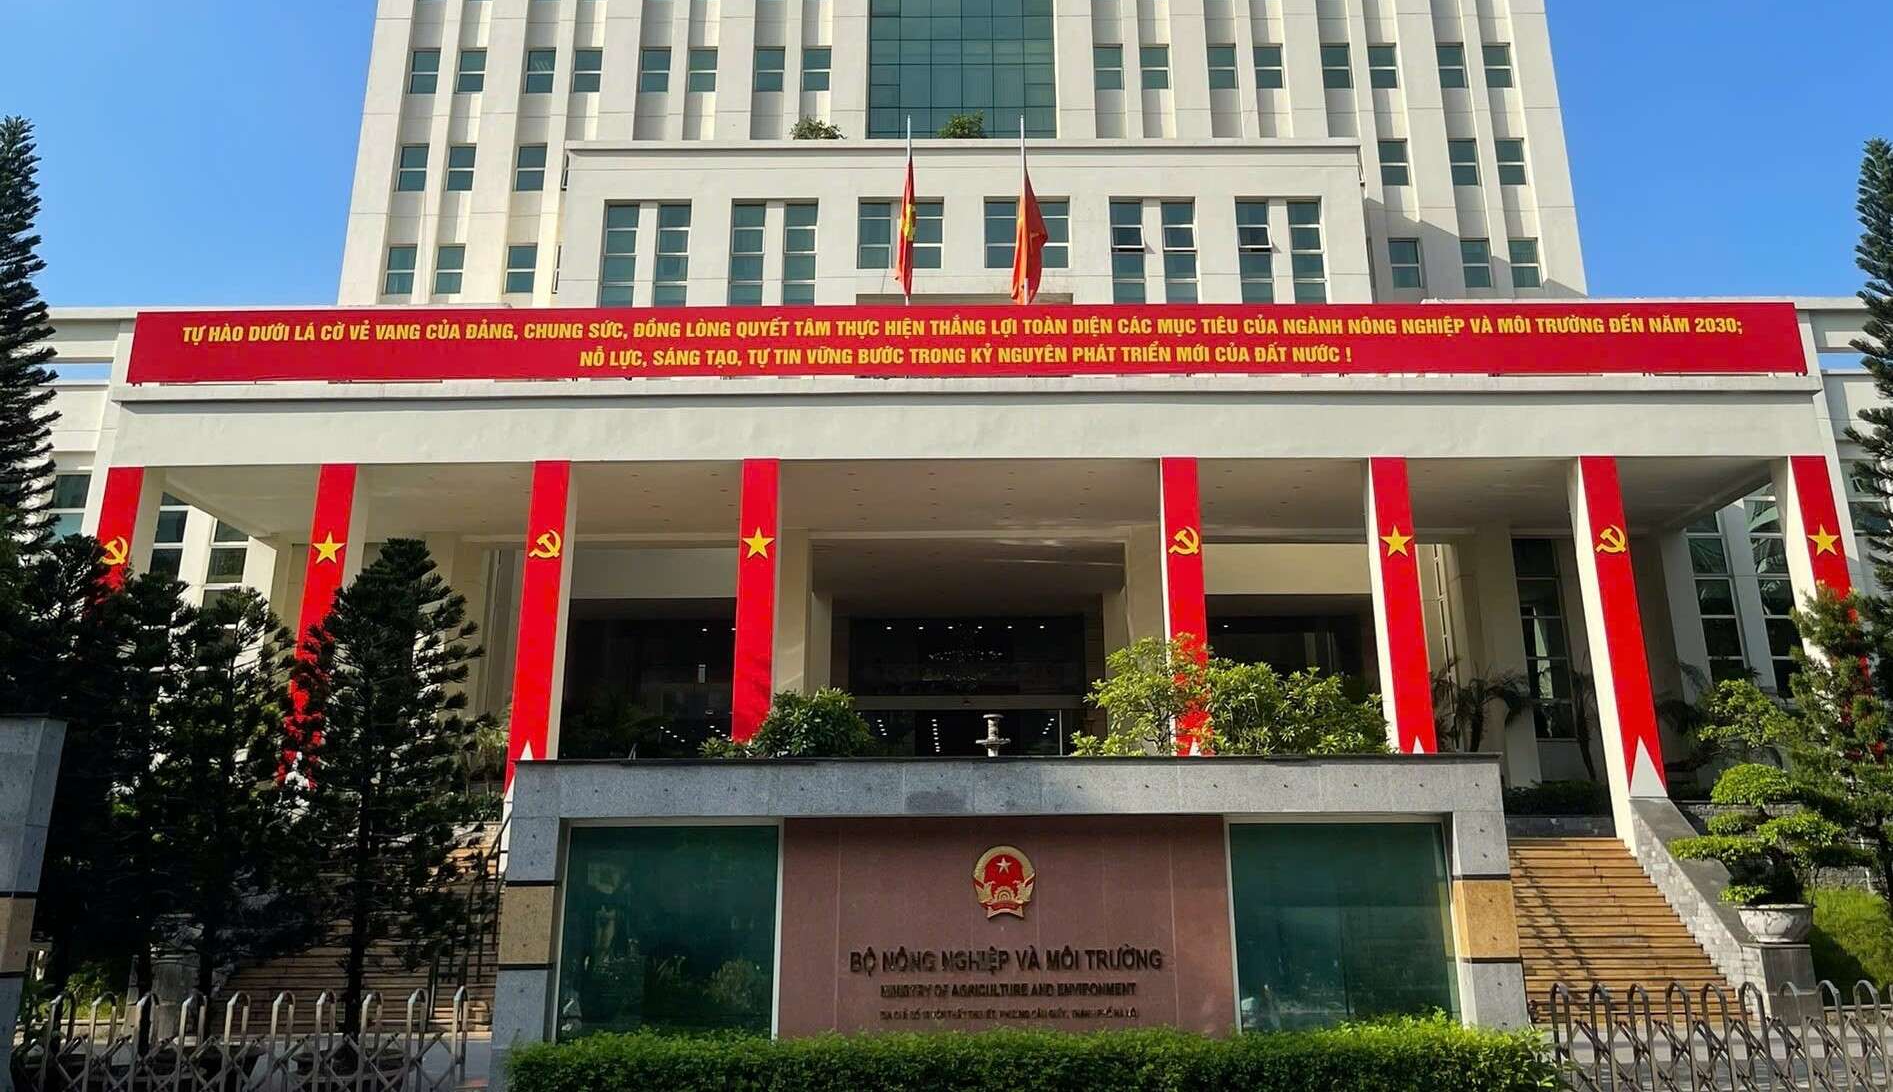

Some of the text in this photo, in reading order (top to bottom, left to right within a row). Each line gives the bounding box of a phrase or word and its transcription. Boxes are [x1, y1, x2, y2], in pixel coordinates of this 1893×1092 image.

[182, 312, 1743, 346] TỰ HÀO DƯỚI LÁ CỜ VẺ VANG CỦA ĐẢNG, CHUNG SỨC, ĐỒNG LÒNG QUYẾT TÂM THỰC HIỆN THẮNG LỢI TOÀN DIỆN CÁC MỤC TIÊU CỦA NGÀNH NÔNG NGHIỆP VÀ MÔI TRƯỜNG ĐẾN NĂM 2030;
[579, 345, 605, 367] NỖ
[609, 348, 648, 370] LỰC,
[652, 346, 701, 366] SÁNG
[704, 349, 743, 369] TẠO,
[746, 347, 772, 369] TỰ
[773, 348, 802, 365] TIN
[806, 345, 853, 365] VỮNG
[857, 345, 905, 365] BƯỚC
[908, 347, 966, 364] TRONG
[970, 342, 994, 364] KỶ
[997, 343, 1068, 364] NGUYÊN
[1071, 343, 1117, 363] PHÁT
[1120, 340, 1172, 363] TRIỂN
[1175, 343, 1210, 363] MỚI
[1214, 341, 1251, 363] CỦA
[1254, 341, 1288, 363] ĐẤT
[1291, 343, 1341, 363] NƯỚC
[849, 942, 1163, 977] BỘ NÔNG NGHIỆP VÀ MÔI TRƯỜNG
